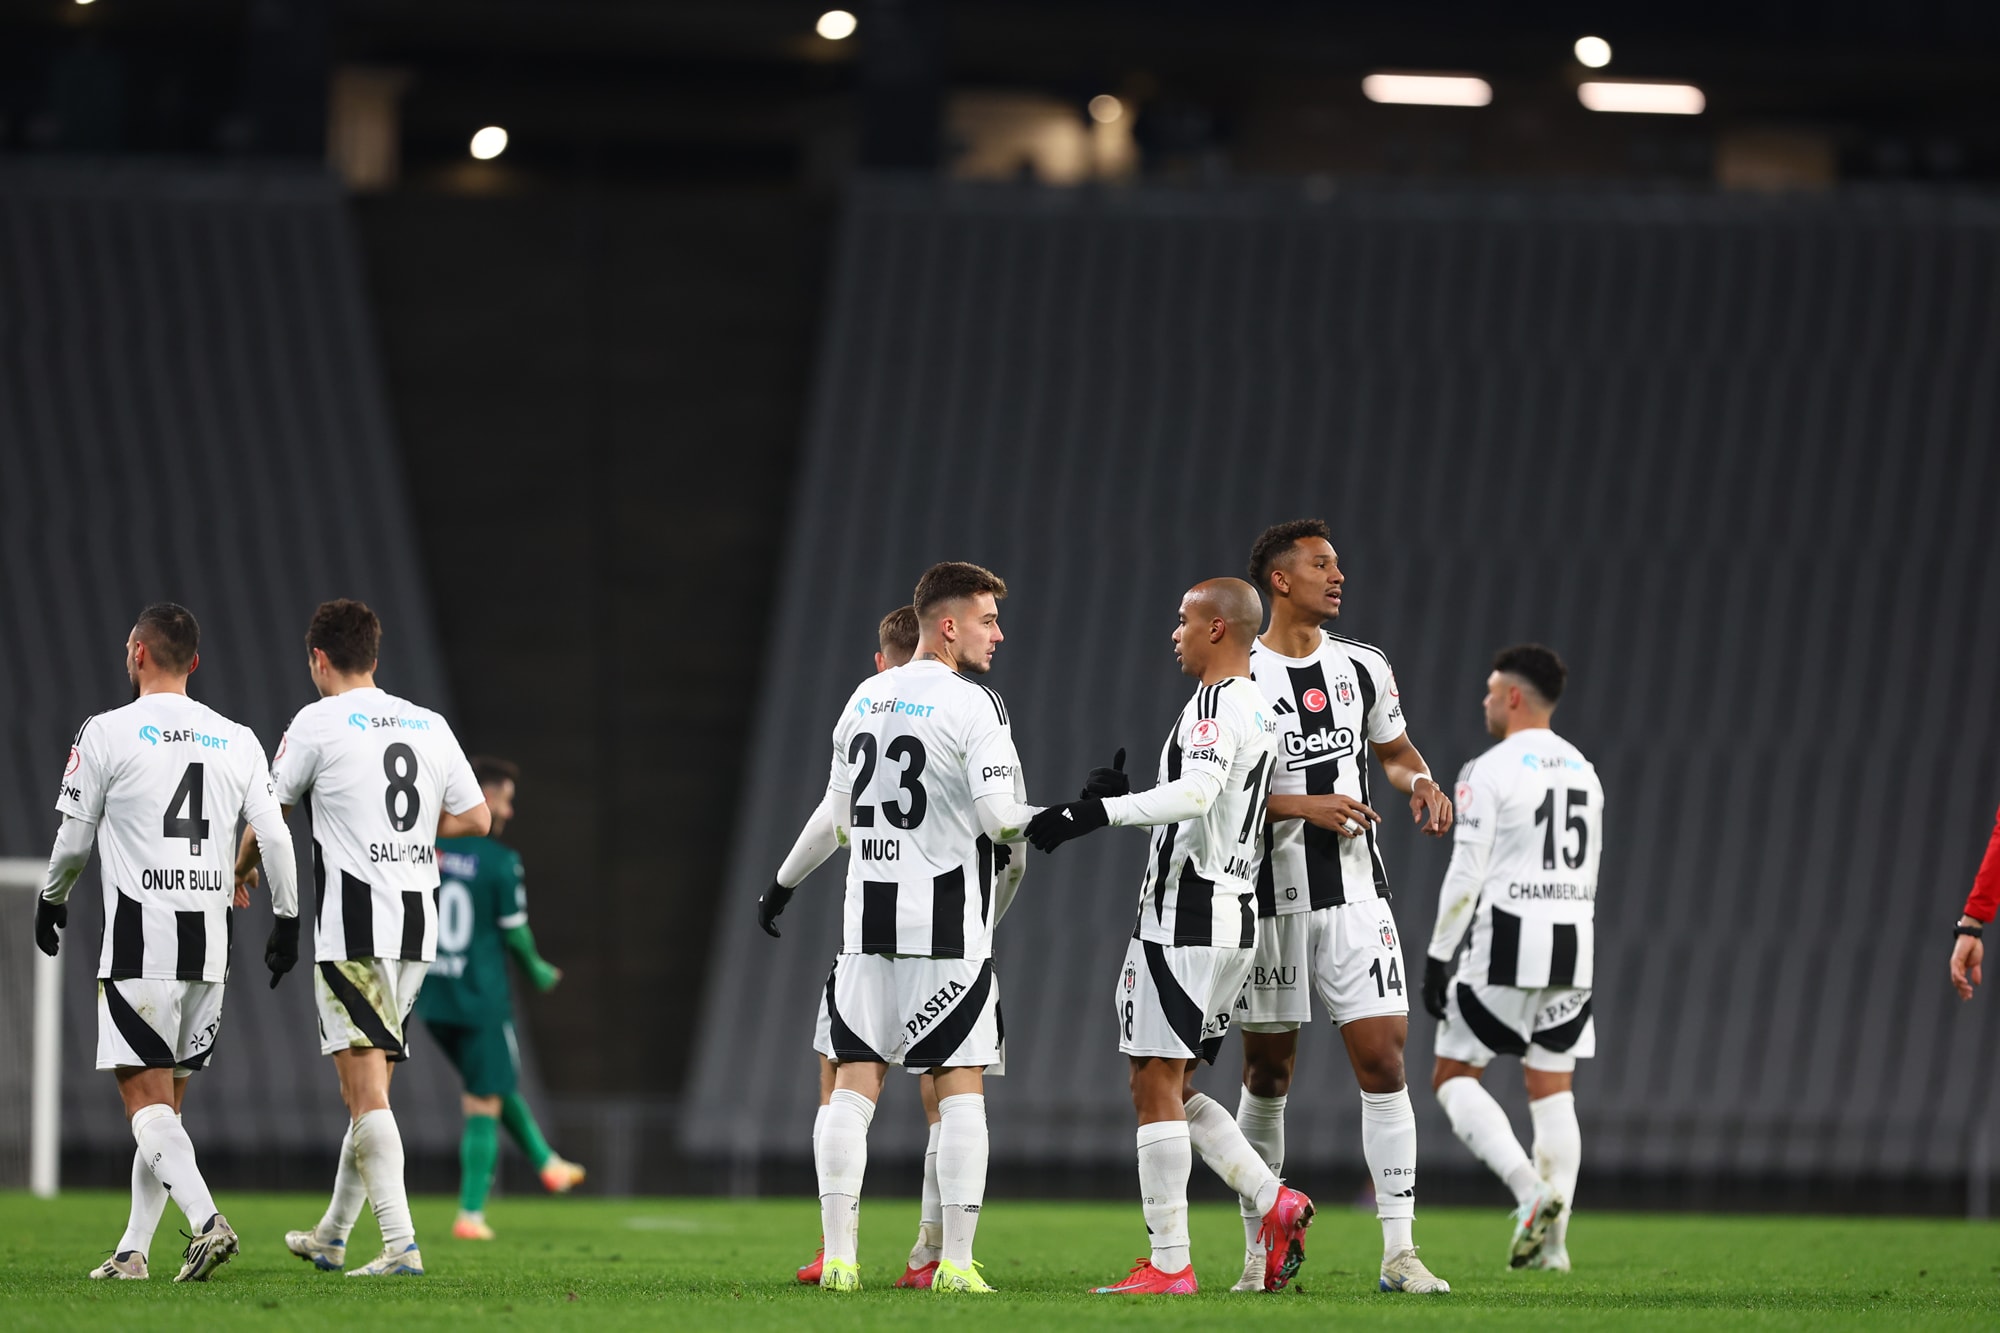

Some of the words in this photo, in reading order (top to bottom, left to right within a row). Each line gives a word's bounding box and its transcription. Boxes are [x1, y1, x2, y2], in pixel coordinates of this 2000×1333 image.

[1284, 727, 1354, 757] beko
[383, 742, 420, 833] 8
[848, 732, 927, 830] 23
[163, 762, 210, 857] 4
[1535, 788, 1588, 871] 15
[861, 839, 900, 861] MUCI
[142, 869, 185, 890] ONUR
[189, 870, 222, 891] BULU
[1254, 966, 1297, 985] BAU
[1369, 957, 1403, 998] 14
[907, 980, 966, 1039] PASHA
